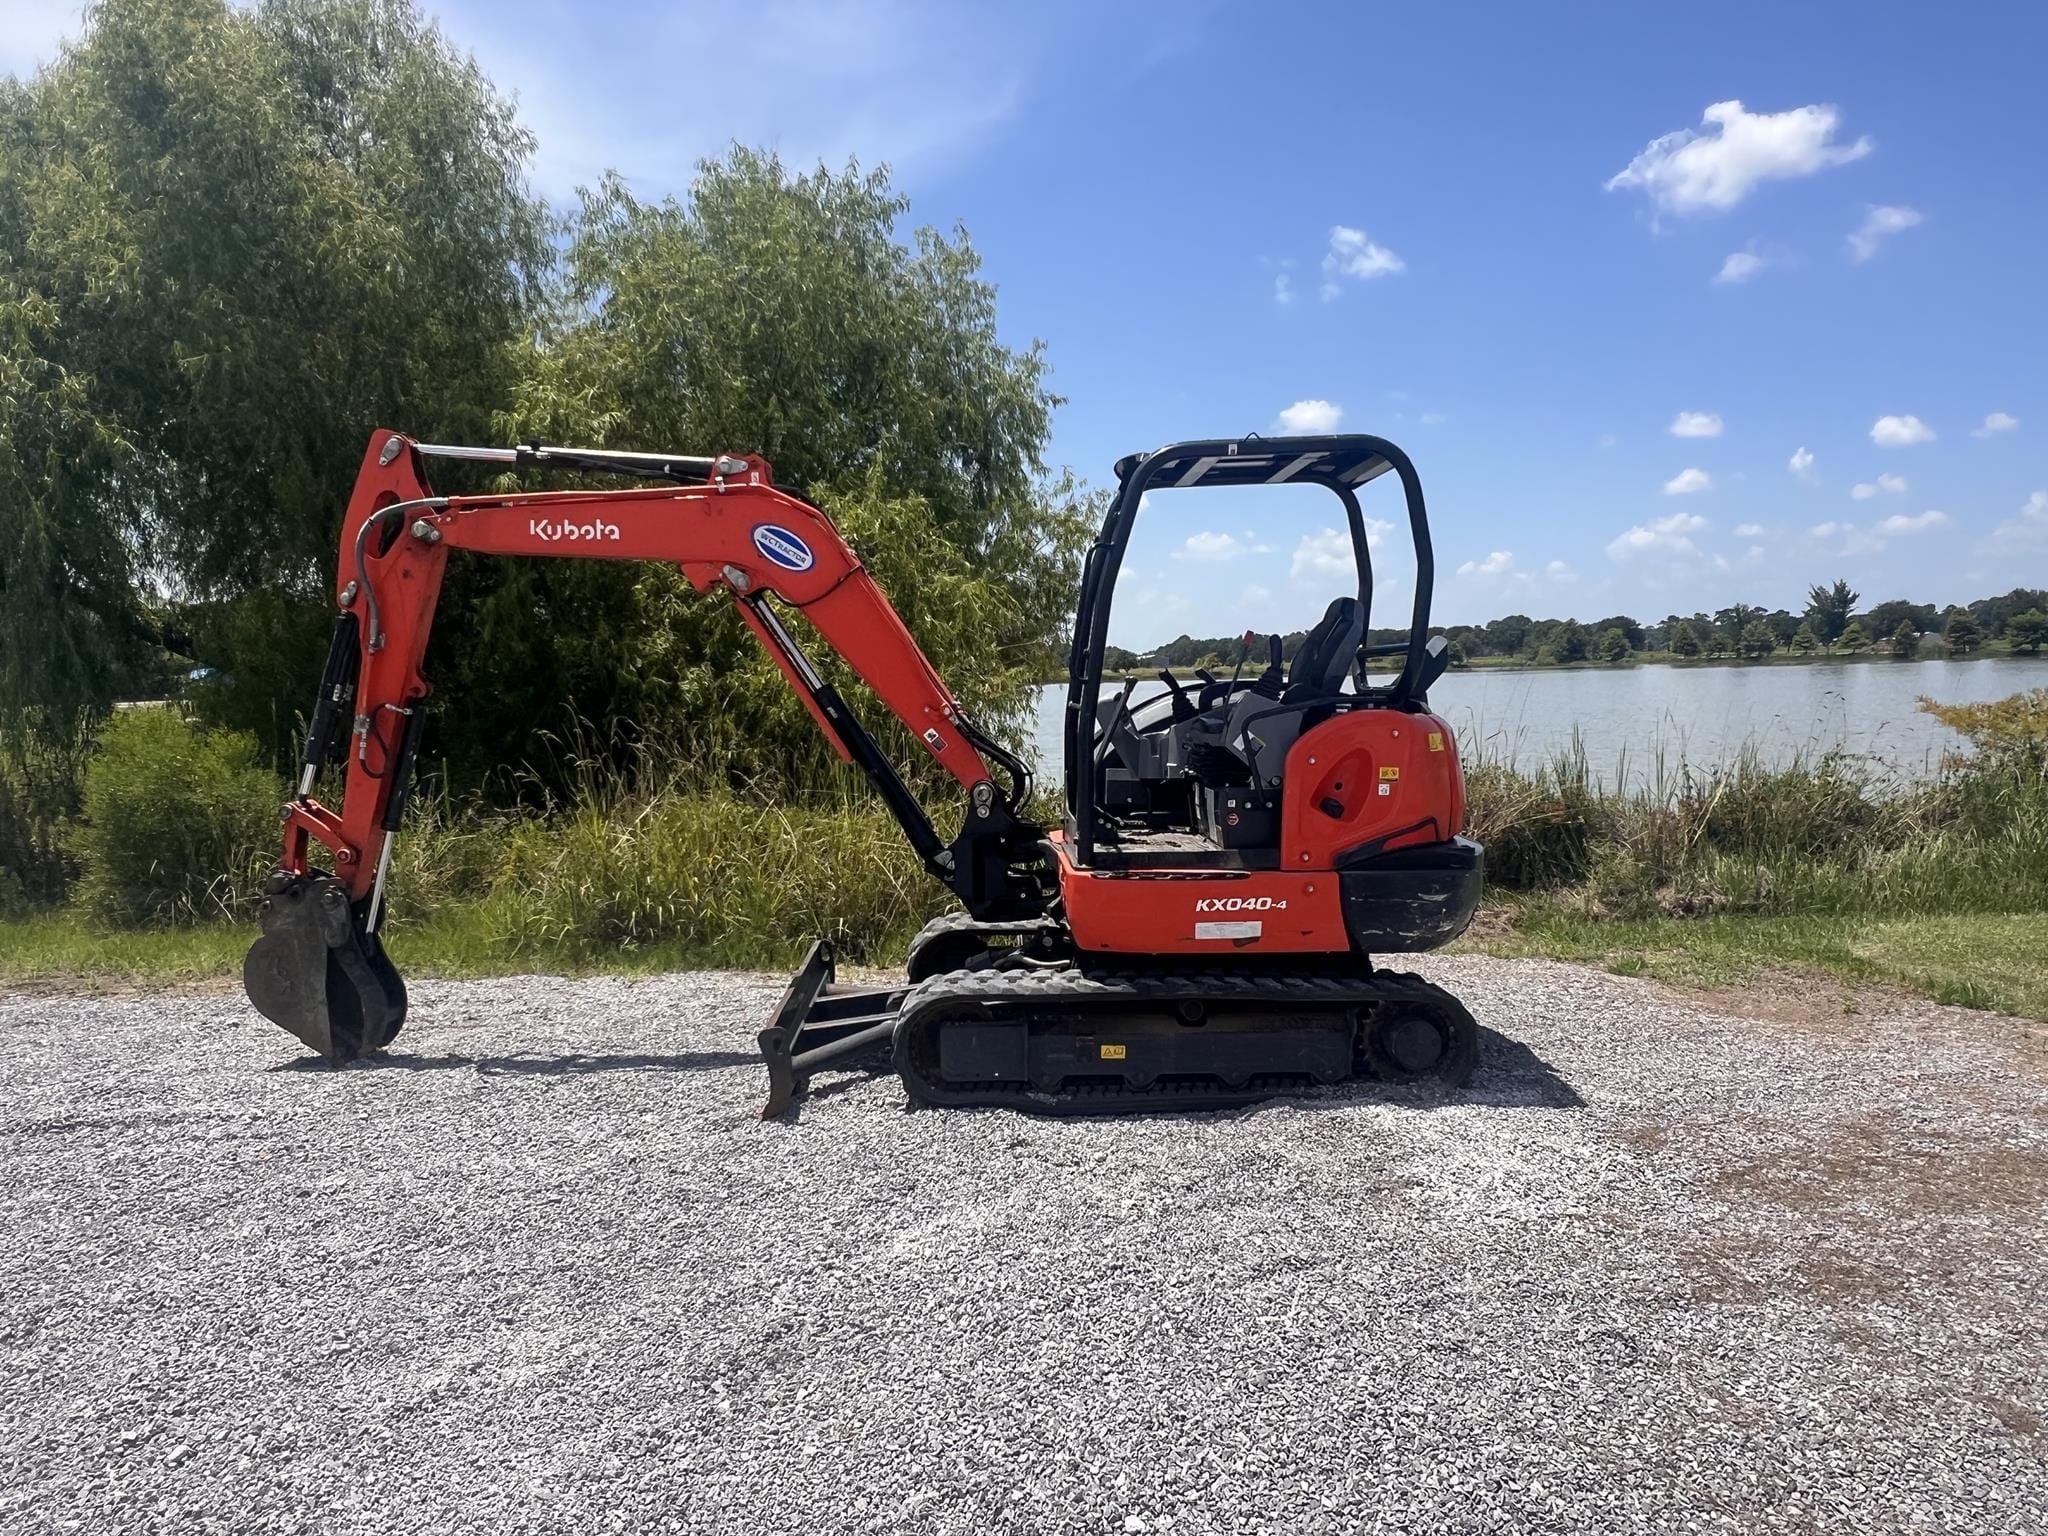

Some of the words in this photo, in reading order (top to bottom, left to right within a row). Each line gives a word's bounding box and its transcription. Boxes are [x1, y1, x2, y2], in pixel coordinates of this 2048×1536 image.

[529, 519, 620, 540] Kubota
[759, 531, 807, 564] WCTRACTOR
[1195, 897, 1287, 911] KX040-4
